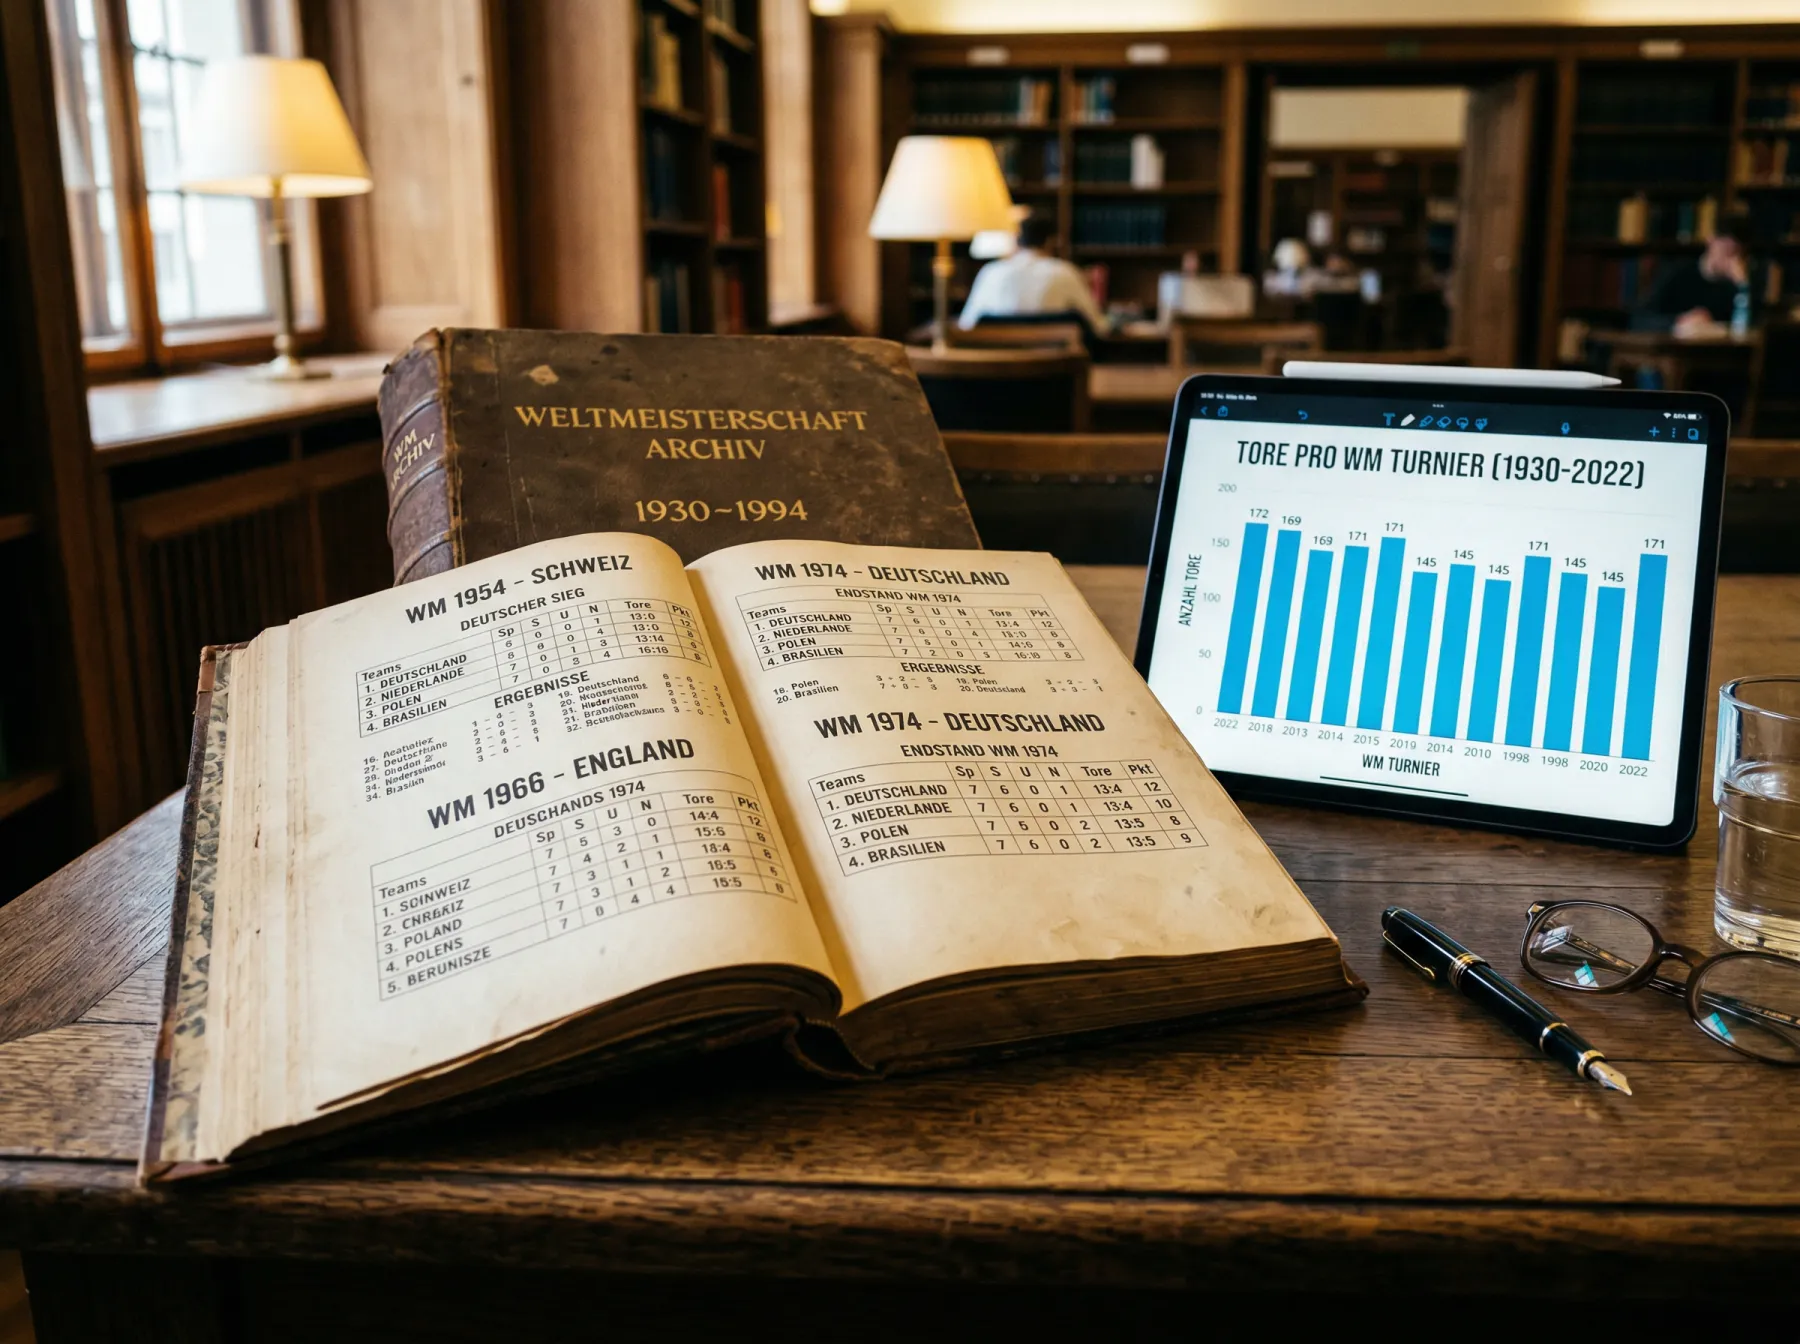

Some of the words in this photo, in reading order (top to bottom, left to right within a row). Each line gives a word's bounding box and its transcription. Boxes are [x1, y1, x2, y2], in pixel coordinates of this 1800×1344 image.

[515, 406, 868, 430] WELTMEISTERSCHAFT
[393, 428, 417, 462] WM
[646, 439, 765, 460] ARCHIV
[1238, 441, 1289, 466] TORE
[1295, 444, 1336, 469] PRO
[1344, 446, 1383, 472] WM
[1390, 448, 1484, 478] TURNIER
[1218, 483, 1237, 492] 200
[1250, 508, 1269, 518] 172
[1282, 516, 1302, 526] 169
[1349, 531, 1367, 541] 171
[1385, 522, 1404, 532] 171
[1212, 538, 1229, 548] 150
[1313, 536, 1333, 546] 169
[1529, 541, 1549, 551] 171
[1644, 539, 1665, 549] 171
[1417, 557, 1436, 567] 145
[1454, 550, 1474, 559] 145
[1565, 558, 1586, 568] 145
[755, 564, 796, 581] WM
[800, 563, 848, 578] 1974
[868, 566, 1010, 586] DEUTSCHLAND
[1185, 554, 1202, 581] TORE
[1489, 565, 1509, 575] 145
[1602, 572, 1624, 582] 145
[406, 598, 446, 624] WM
[454, 579, 506, 608] 1954
[531, 555, 632, 585] SCHWEIZ
[835, 588, 903, 600] ENDSTAND
[906, 592, 930, 602] WM
[933, 594, 961, 603] 1974
[1203, 593, 1220, 602] 100
[461, 597, 547, 631] DEUTSCHER
[551, 588, 585, 603] SIEG
[747, 605, 787, 620] Teams
[877, 604, 892, 614] Sp
[907, 606, 914, 614] S
[932, 608, 941, 616] U
[1178, 581, 1197, 626] ANZAHL
[755, 623, 765, 631] 1.
[769, 614, 852, 628] DEUTSCHLAND
[362, 664, 401, 681] Teams
[498, 628, 514, 639] Sp
[532, 619, 540, 627] S
[560, 611, 569, 619] U
[589, 605, 599, 613] N
[625, 601, 651, 609] Tore
[673, 605, 691, 618] Pkt
[758, 635, 770, 643] 2.
[773, 625, 852, 639] NIEDERLANDE
[762, 646, 774, 655] 3.
[778, 638, 816, 650] POLEN
[767, 658, 779, 666] 4.
[782, 647, 843, 662] BRASILIEN
[1199, 650, 1211, 659] 50
[380, 654, 467, 689] DEUTSCHLAND
[901, 662, 985, 675] ERGEBNISSE
[365, 697, 376, 706] 2.
[381, 667, 465, 701] NIEDERLANDE
[494, 671, 590, 709] ERGEBNISSE
[578, 676, 639, 693] Deutschland
[777, 695, 792, 704] 20.
[795, 684, 839, 699] Brasilien
[792, 679, 819, 690] Polen
[366, 710, 377, 719] 3.
[382, 694, 422, 714] POLEN
[367, 723, 378, 732] 4.
[383, 699, 447, 727] BRASILIEN
[1196, 706, 1202, 714] 0
[814, 714, 862, 739] WM
[867, 712, 922, 732] 1974
[944, 713, 1106, 732] DEUTSCHLAND
[900, 744, 986, 757] ENDSTAND
[988, 744, 1019, 757] WM
[1021, 745, 1059, 757] 1974
[1214, 718, 1238, 729] 2022
[1248, 722, 1273, 733] 2018
[1282, 726, 1308, 737] 2013
[1318, 730, 1343, 742] 2014
[1353, 734, 1379, 746] 2015
[1390, 739, 1416, 750] 2019
[1427, 743, 1453, 754] 2014
[1464, 747, 1491, 759] 2010
[1504, 752, 1530, 763] 1998
[1542, 756, 1568, 768] 1998
[1580, 760, 1608, 772] 2020
[1619, 765, 1647, 777] 2022
[1362, 754, 1384, 770] WM
[1388, 757, 1440, 776] TURNIER
[428, 795, 476, 829] WM
[483, 771, 545, 810] 1966
[573, 738, 694, 780] ENGLAND
[817, 774, 866, 792] Teams
[957, 765, 975, 778] Sp
[990, 766, 1001, 777] S
[1020, 766, 1031, 778] U
[1049, 766, 1061, 778] N
[1081, 766, 1112, 777] Tore
[1128, 764, 1154, 775] Pkt
[827, 801, 840, 811] 1.
[844, 784, 947, 806] DEUTSCHLAND
[1093, 784, 1122, 795] 13:4
[1144, 781, 1161, 792] 12
[494, 791, 604, 839] DEUSCHANDS
[608, 780, 646, 798] 1974
[832, 819, 847, 830] 2.
[852, 802, 952, 824] NIEDERLANDE
[1104, 800, 1133, 812] 13:4
[1155, 798, 1172, 810] 10
[840, 837, 856, 849] 3.
[860, 824, 909, 843] POLEN
[1115, 818, 1145, 830] 13:5
[1170, 815, 1180, 826] 8
[380, 877, 427, 899] Teams
[536, 830, 555, 843] Sp
[574, 819, 584, 830] S
[608, 808, 618, 820] U
[640, 800, 652, 810] N
[683, 794, 714, 804] Tore
[738, 796, 760, 812] Pkt
[849, 856, 864, 868] 4.
[868, 841, 946, 863] BRASILIEN
[1126, 835, 1156, 848] 13:5
[1181, 833, 1192, 844] 9
[383, 907, 394, 917] 1.
[690, 810, 719, 821] 14:4
[747, 816, 762, 827] 12
[383, 925, 396, 936] 2.
[385, 943, 398, 954] 3.
[404, 919, 462, 947] POLAND
[386, 962, 399, 972] 4.
[406, 938, 463, 967] POLENS
[388, 981, 401, 993] 5.
[408, 946, 491, 986] BERUNISZE
